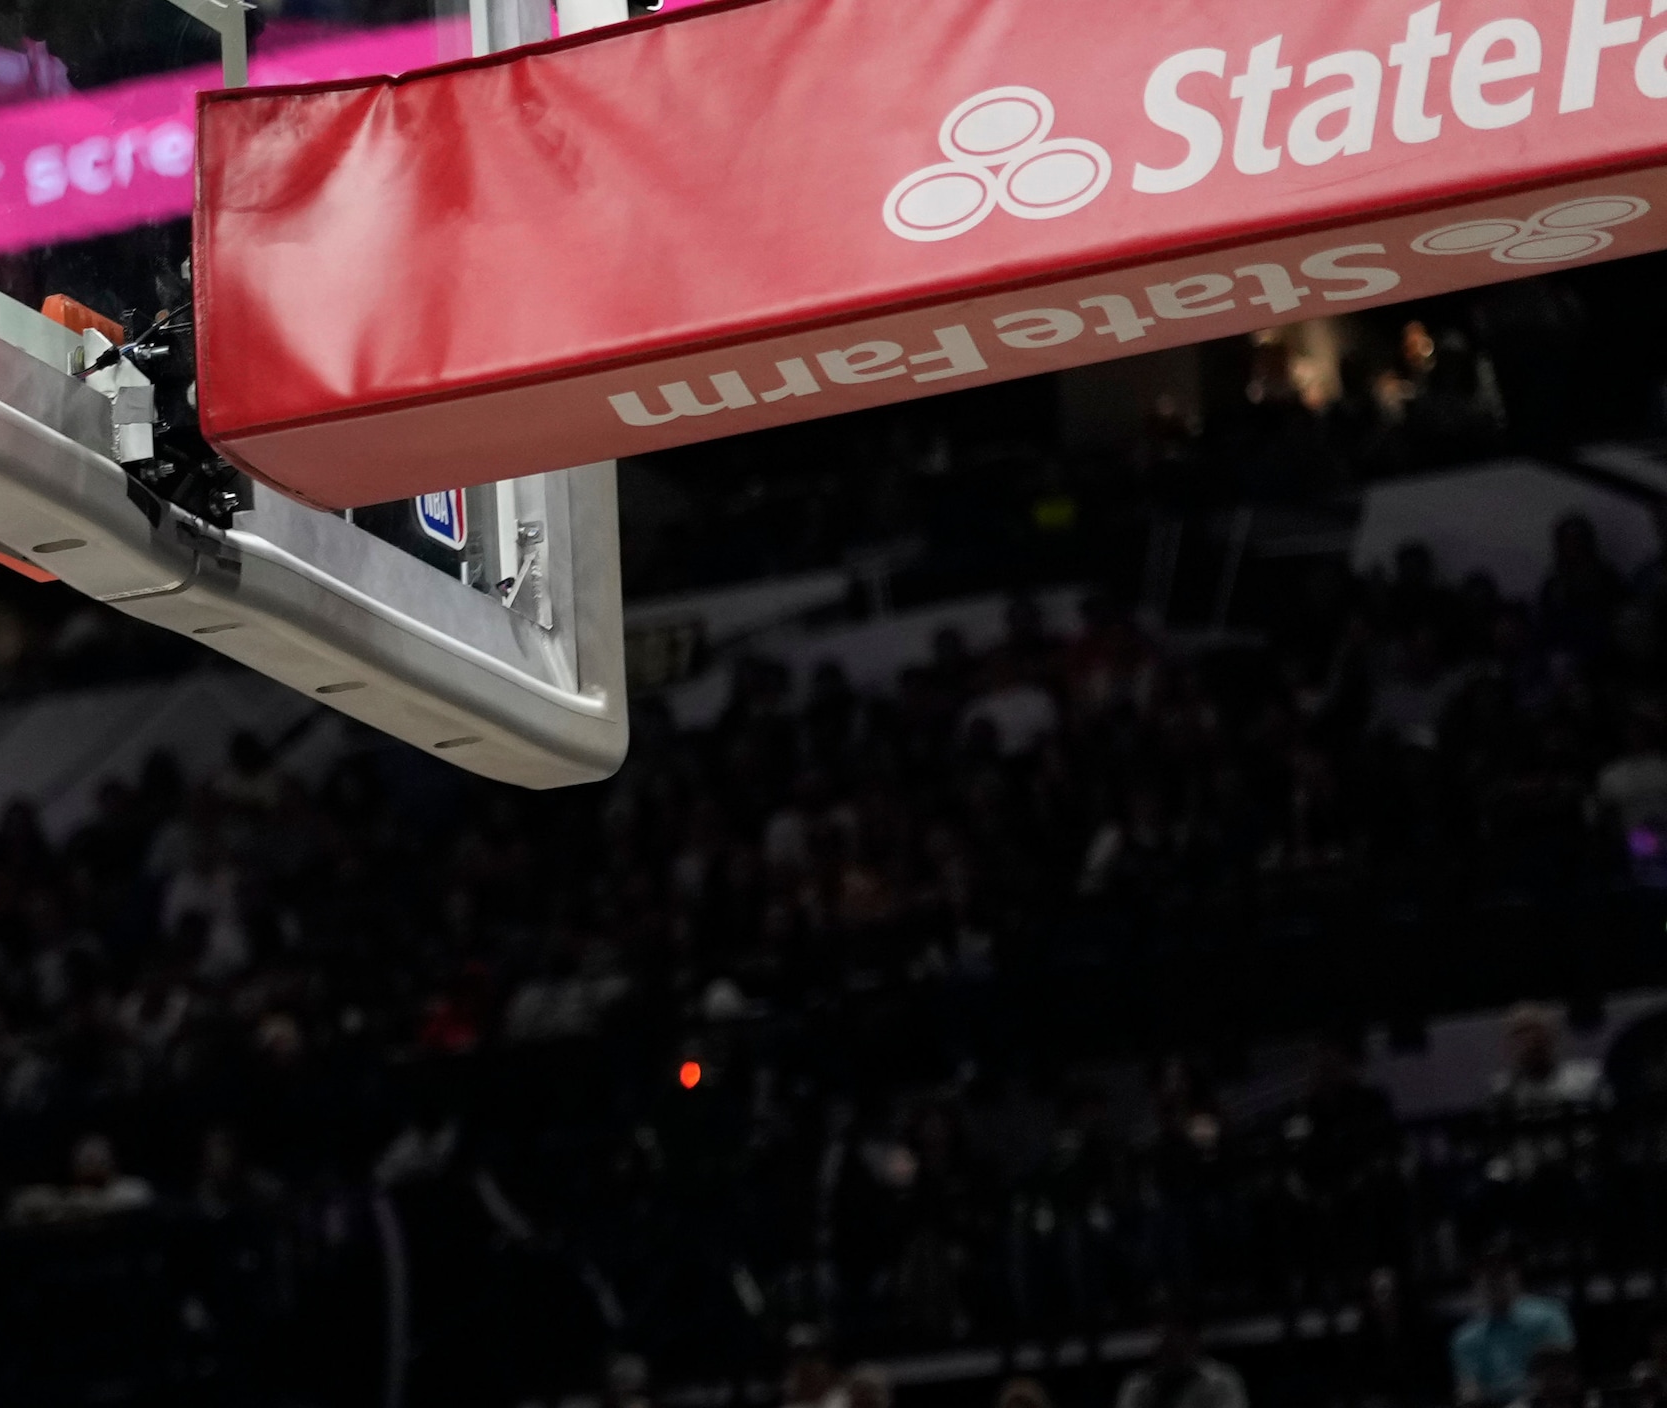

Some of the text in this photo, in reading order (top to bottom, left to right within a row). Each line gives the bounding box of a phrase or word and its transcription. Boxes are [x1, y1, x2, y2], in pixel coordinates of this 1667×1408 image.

[1132, 0, 1541, 194] State
[608, 243, 1401, 427] State Farm
